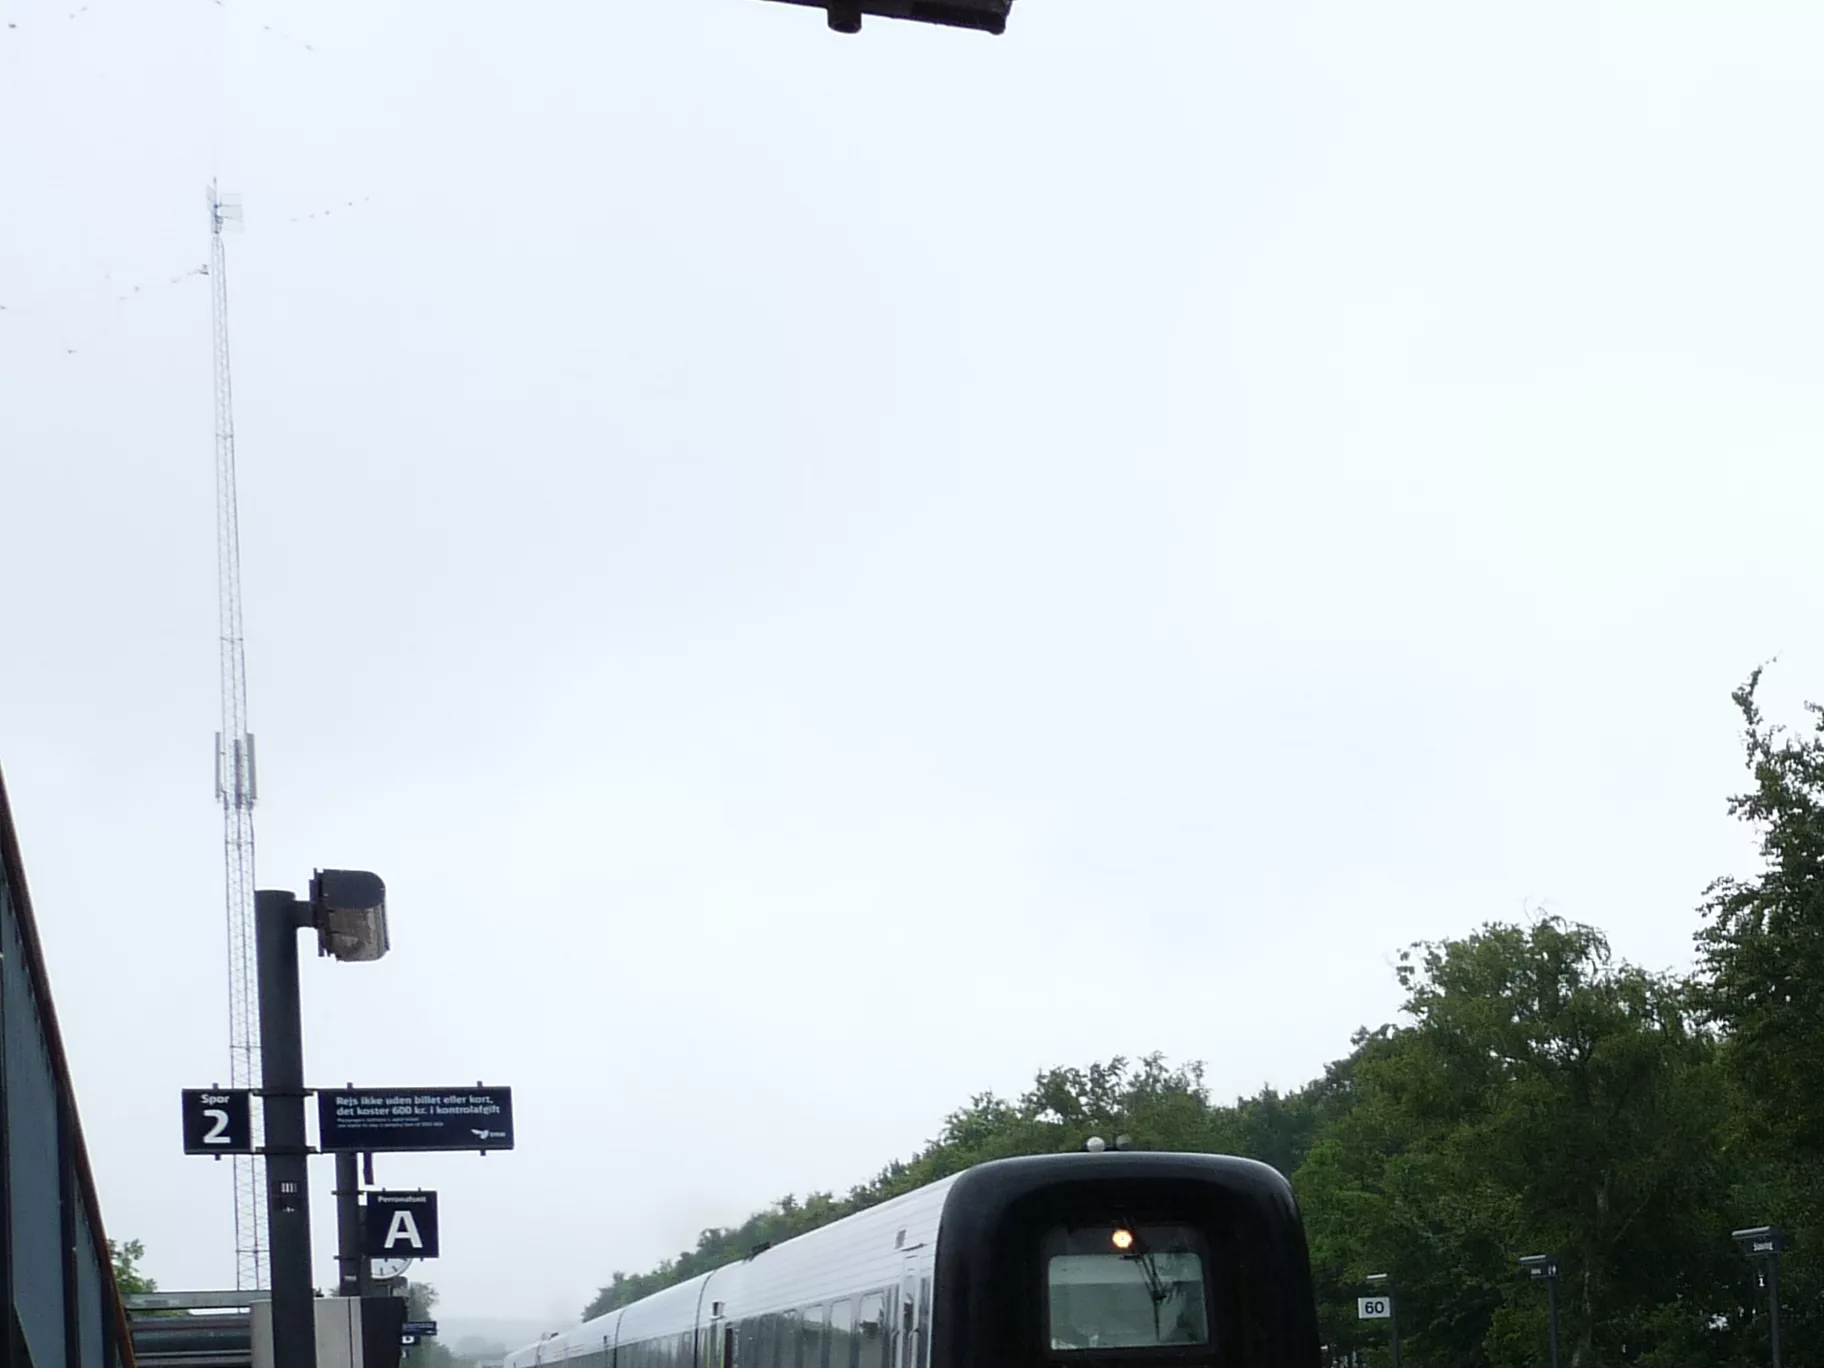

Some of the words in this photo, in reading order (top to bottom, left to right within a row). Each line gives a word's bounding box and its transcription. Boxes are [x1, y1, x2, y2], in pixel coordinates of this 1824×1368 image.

[200, 1093, 230, 1105] Spor
[336, 1096, 358, 1107] Rejs
[361, 1096, 384, 1105] ikke
[386, 1096, 411, 1105] uden
[414, 1095, 441, 1104] billet
[443, 1095, 467, 1104] eller
[336, 1106, 354, 1116] det
[356, 1106, 389, 1115] koster
[392, 1105, 412, 1115] 600
[436, 1104, 500, 1116] kontrolafgift
[203, 1109, 231, 1144] 2
[383, 1210, 423, 1249] A
[1364, 1301, 1385, 1315] 60
